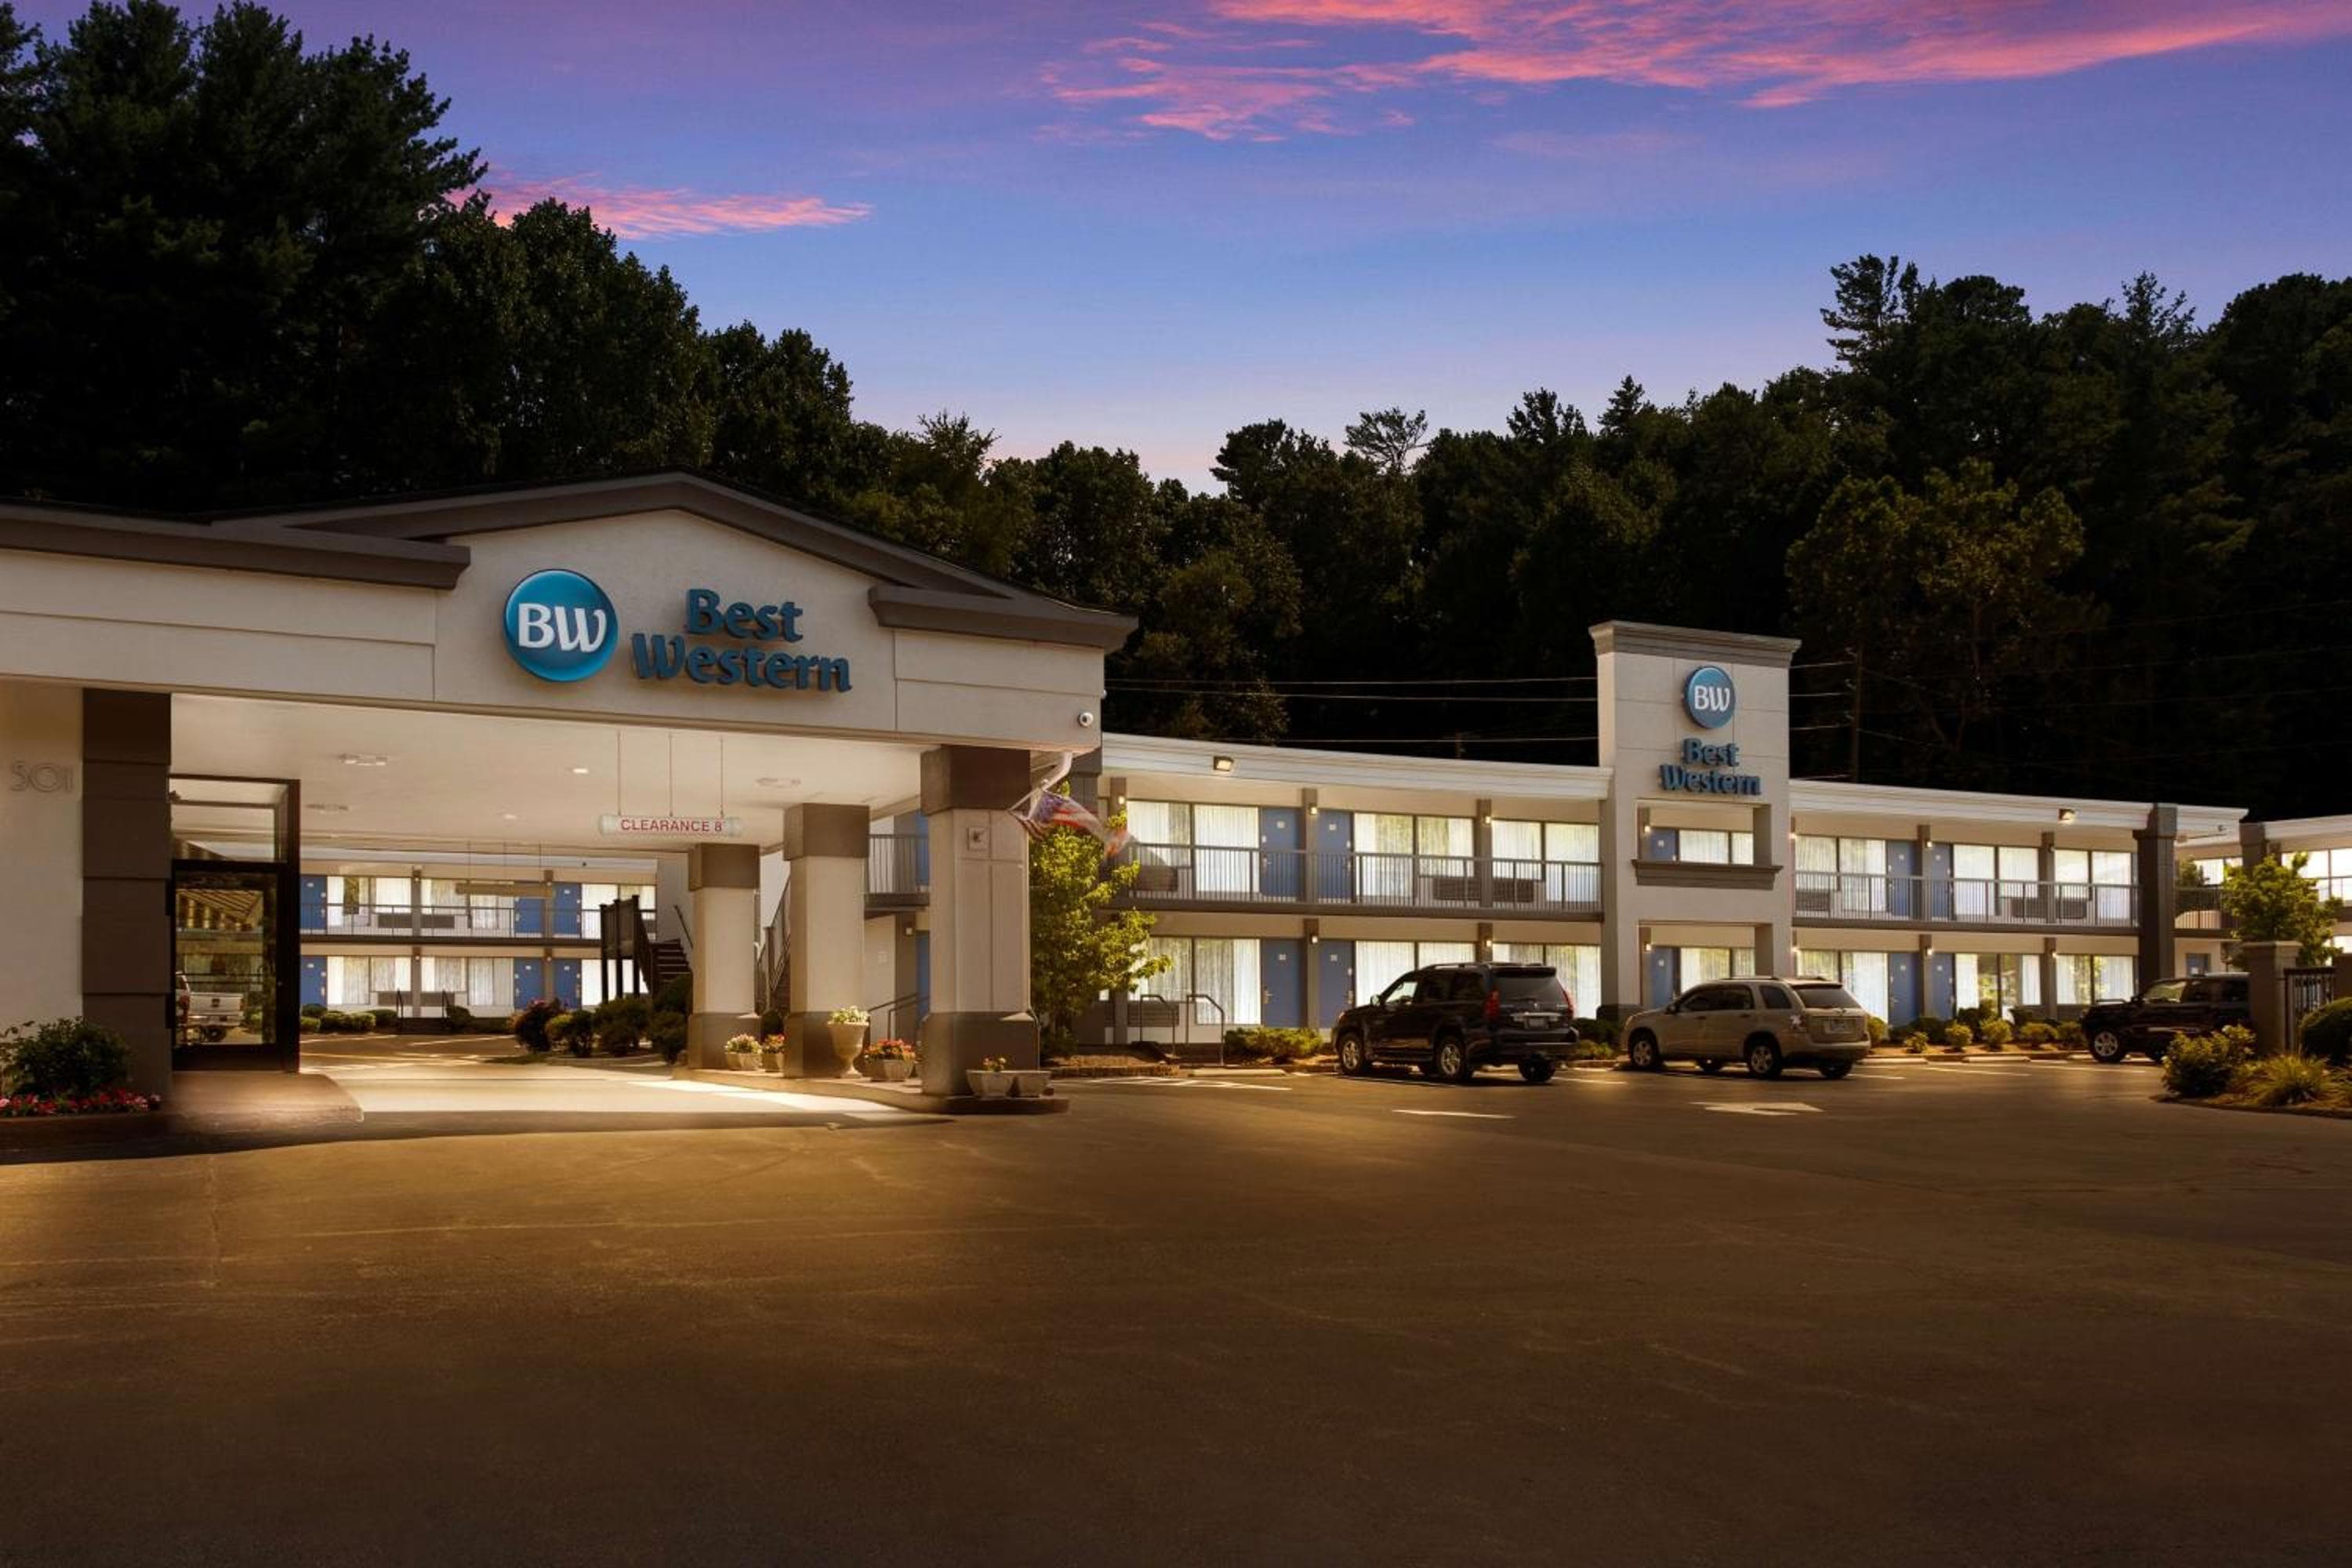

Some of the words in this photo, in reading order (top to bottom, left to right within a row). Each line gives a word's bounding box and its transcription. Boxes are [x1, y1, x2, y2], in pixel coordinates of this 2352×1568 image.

[517, 602, 607, 653] BW
[685, 588, 804, 644] Best
[630, 633, 853, 692] Western
[1693, 684, 1730, 711] BW
[1682, 738, 1740, 767] Best
[1659, 764, 1762, 796] Western
[620, 818, 710, 832] CLEARANCE
